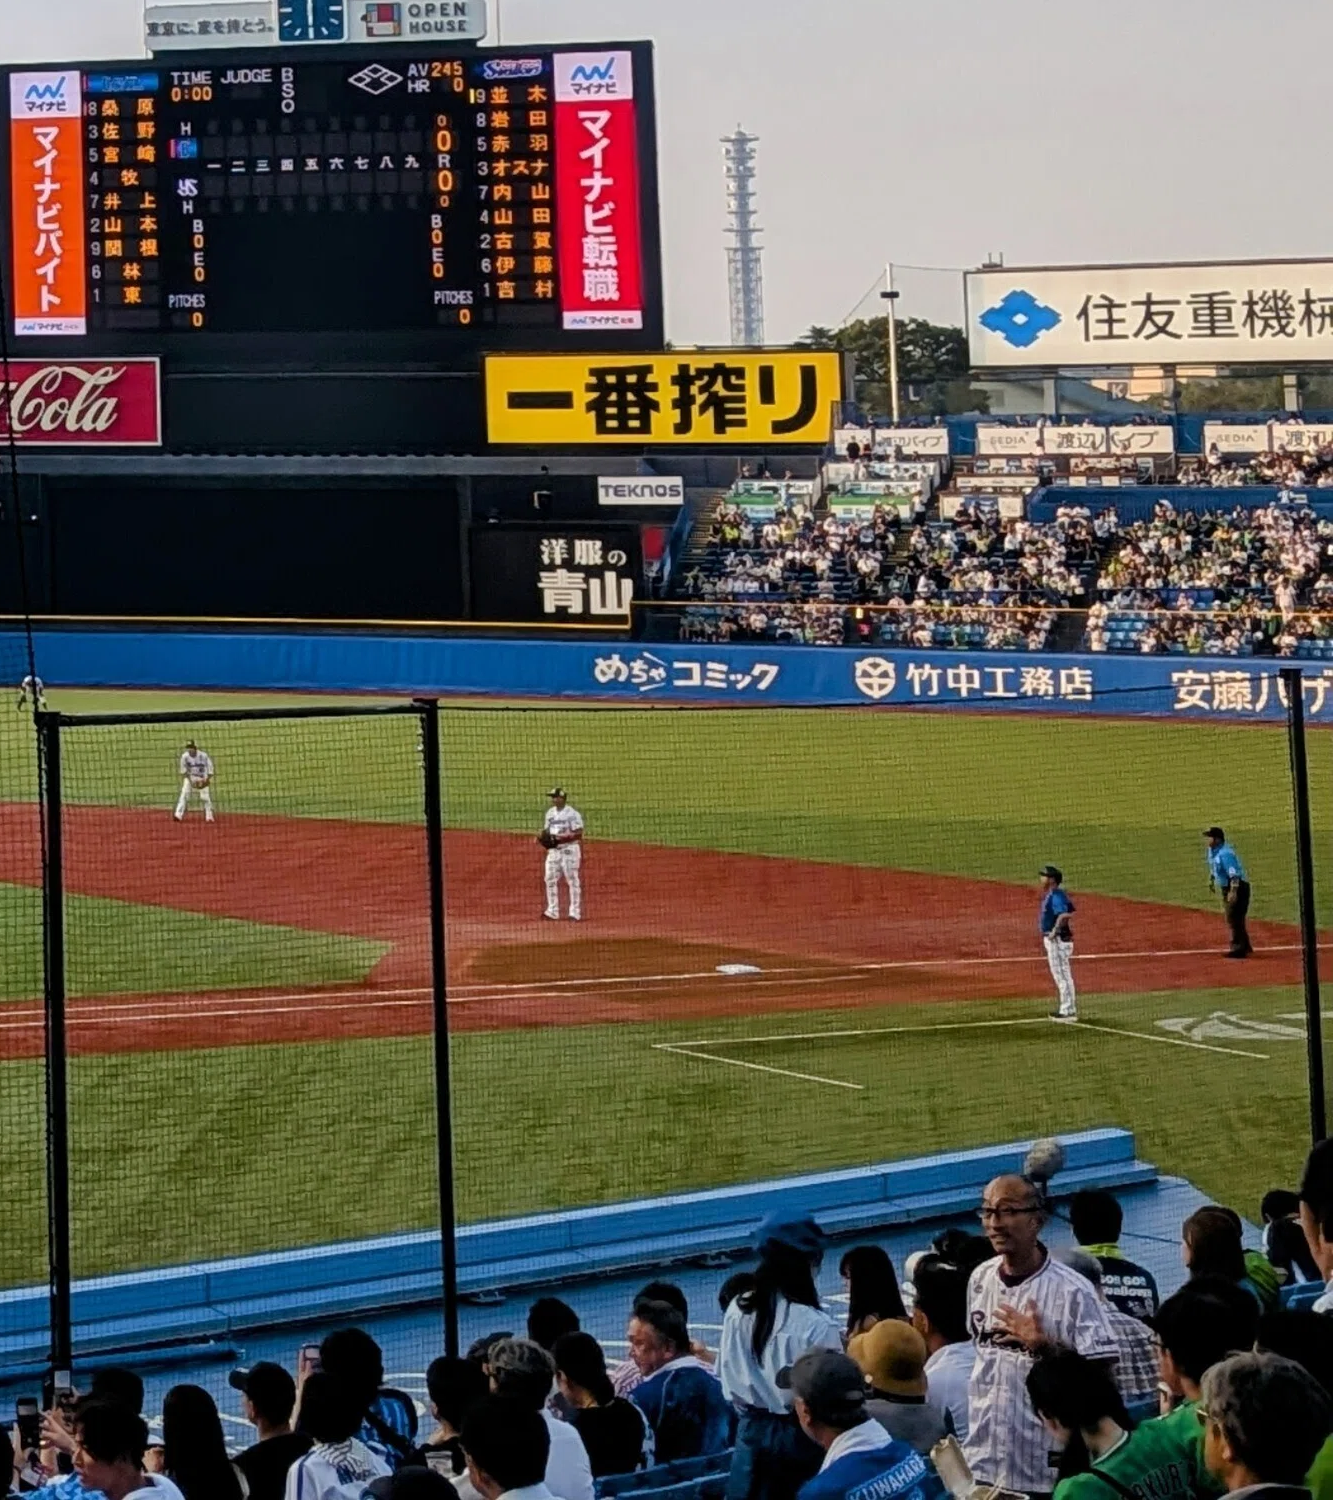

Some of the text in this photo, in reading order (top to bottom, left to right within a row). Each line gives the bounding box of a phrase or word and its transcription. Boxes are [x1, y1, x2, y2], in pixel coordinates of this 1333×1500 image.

[408, 2, 467, 17] OPEN
[409, 19, 467, 33] HOUSE
[220, 68, 272, 84] JUDGE
[281, 67, 294, 82] B
[408, 61, 463, 77] AV 245
[171, 71, 212, 85] TIME
[407, 78, 464, 93] HR 0
[171, 86, 212, 102] 0:00
[281, 83, 295, 98] S
[476, 88, 486, 104] 9
[570, 82, 617, 95] マイナビ
[24, 101, 67, 112] マイナビ
[88, 101, 97, 115] 8
[437, 115, 447, 127] 0
[476, 112, 487, 128] 8
[88, 125, 98, 139] 3
[180, 122, 191, 136] H
[437, 129, 452, 151] 0
[477, 137, 487, 152] 5
[88, 148, 98, 163] 5
[437, 154, 450, 168] R
[230, 160, 246, 172] 二
[255, 159, 271, 172] 三
[281, 158, 294, 171] 四
[304, 157, 319, 171] 五
[329, 157, 345, 170] 六
[354, 156, 370, 170] 七
[379, 156, 394, 169] 八
[404, 155, 419, 169] 九
[477, 159, 549, 176] 3 オスナ
[89, 169, 139, 187] 4 牧
[438, 170, 453, 191] 0
[479, 185, 488, 199] 7
[90, 195, 99, 209] 7
[182, 200, 193, 214] H
[440, 195, 450, 208] 0
[578, 109, 620, 302] マイナビ転職
[431, 214, 442, 229] B
[480, 209, 489, 224] 4
[90, 219, 100, 233] 2
[193, 219, 203, 233] B
[193, 234, 204, 249] 0
[432, 229, 443, 244] 0
[480, 235, 491, 249] 2
[90, 242, 100, 256] 9
[432, 248, 443, 262] E
[194, 251, 204, 266] E
[480, 259, 491, 273] 6
[91, 262, 141, 280] 6 林
[194, 267, 205, 282] 0
[433, 263, 444, 278] 0
[92, 288, 100, 303] 1
[434, 290, 473, 305] PITCHES
[483, 283, 491, 298] 1
[168, 294, 205, 308] PITCHES
[193, 312, 203, 327] 0
[459, 309, 471, 324] 0
[1076, 287, 1333, 343] 住友重機械
[506, 363, 818, 436] 一番搾り
[909, 385, 920, 401] L
[1111, 385, 1124, 399] K
[600, 483, 682, 498] TEKNOS
[540, 538, 627, 567] 洋服の
[537, 569, 633, 615] 青山
[594, 653, 779, 691] めちゃコミック
[905, 662, 1093, 701] 竹中工務店
